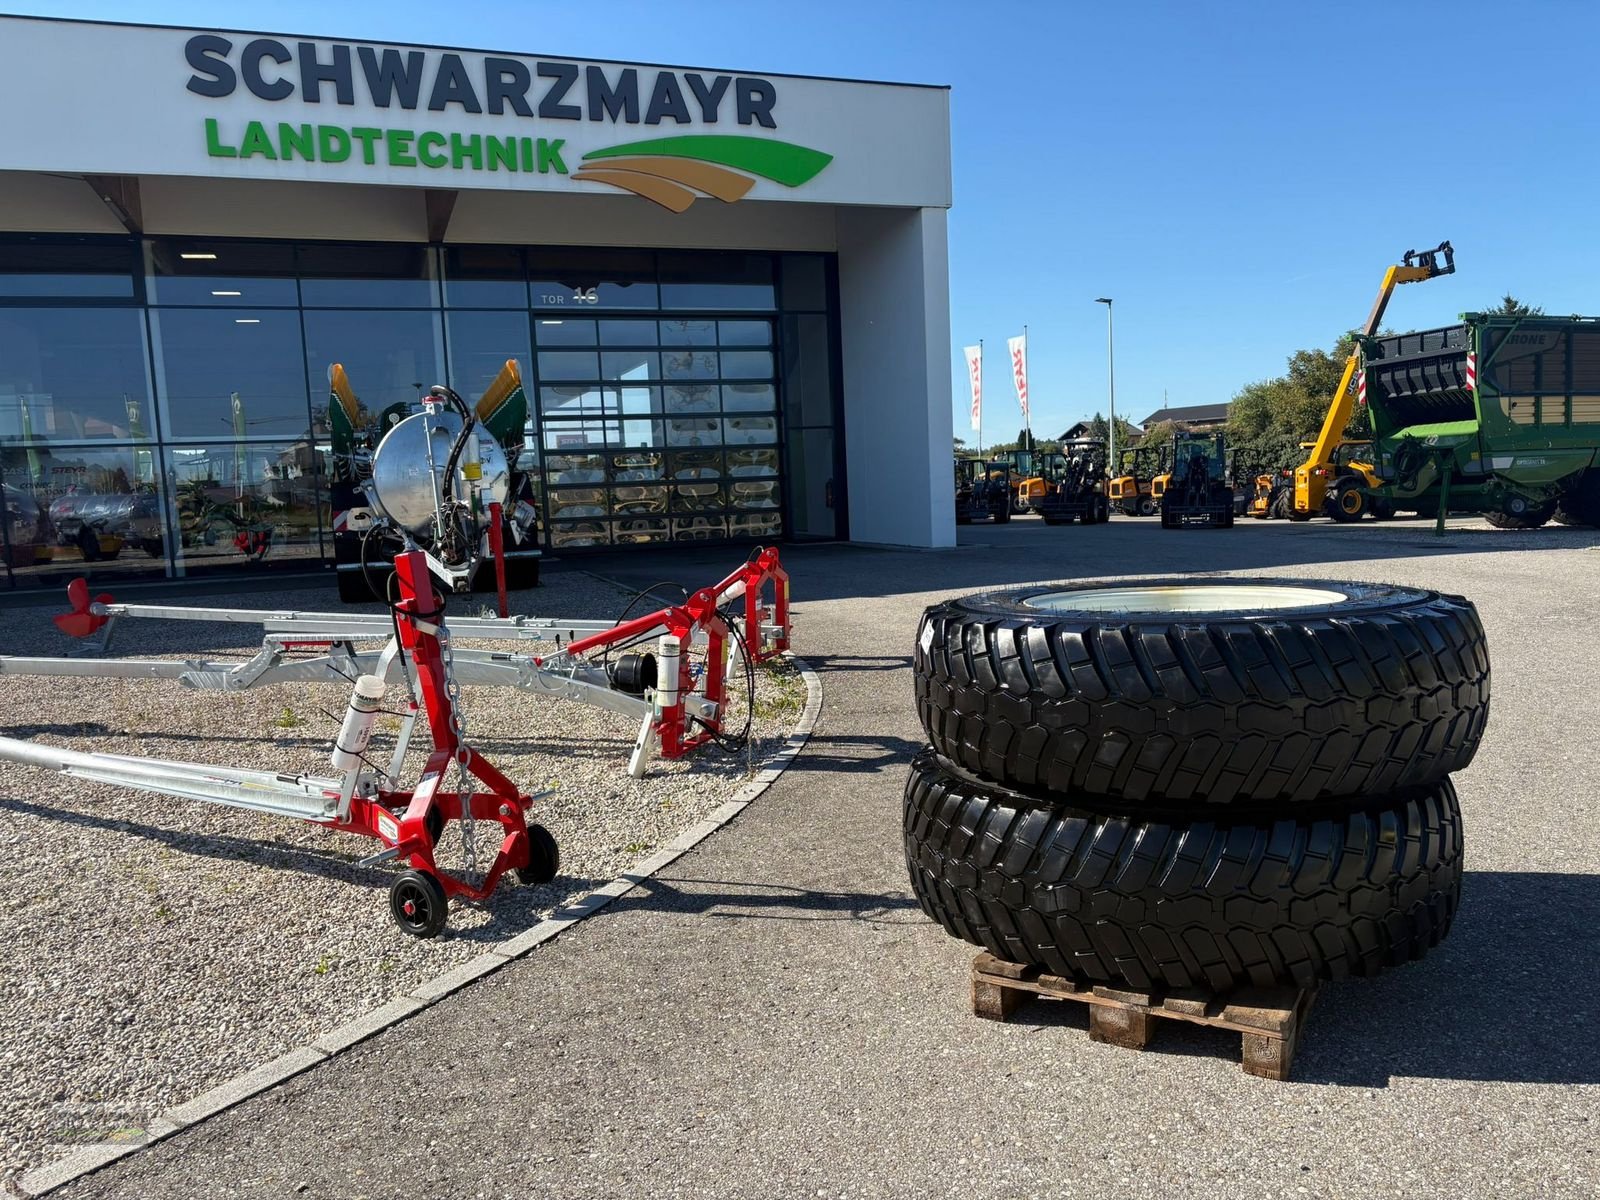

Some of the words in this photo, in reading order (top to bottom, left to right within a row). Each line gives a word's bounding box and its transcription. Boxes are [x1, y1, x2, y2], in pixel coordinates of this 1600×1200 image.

[184, 34, 778, 129] SCHWARZMAYR
[205, 118, 569, 175] LANDTECHNIK
[541, 295, 565, 304] TOR
[574, 286, 599, 304] 16
[1506, 334, 1546, 344] RONE
[51, 466, 86, 474] STEYR
